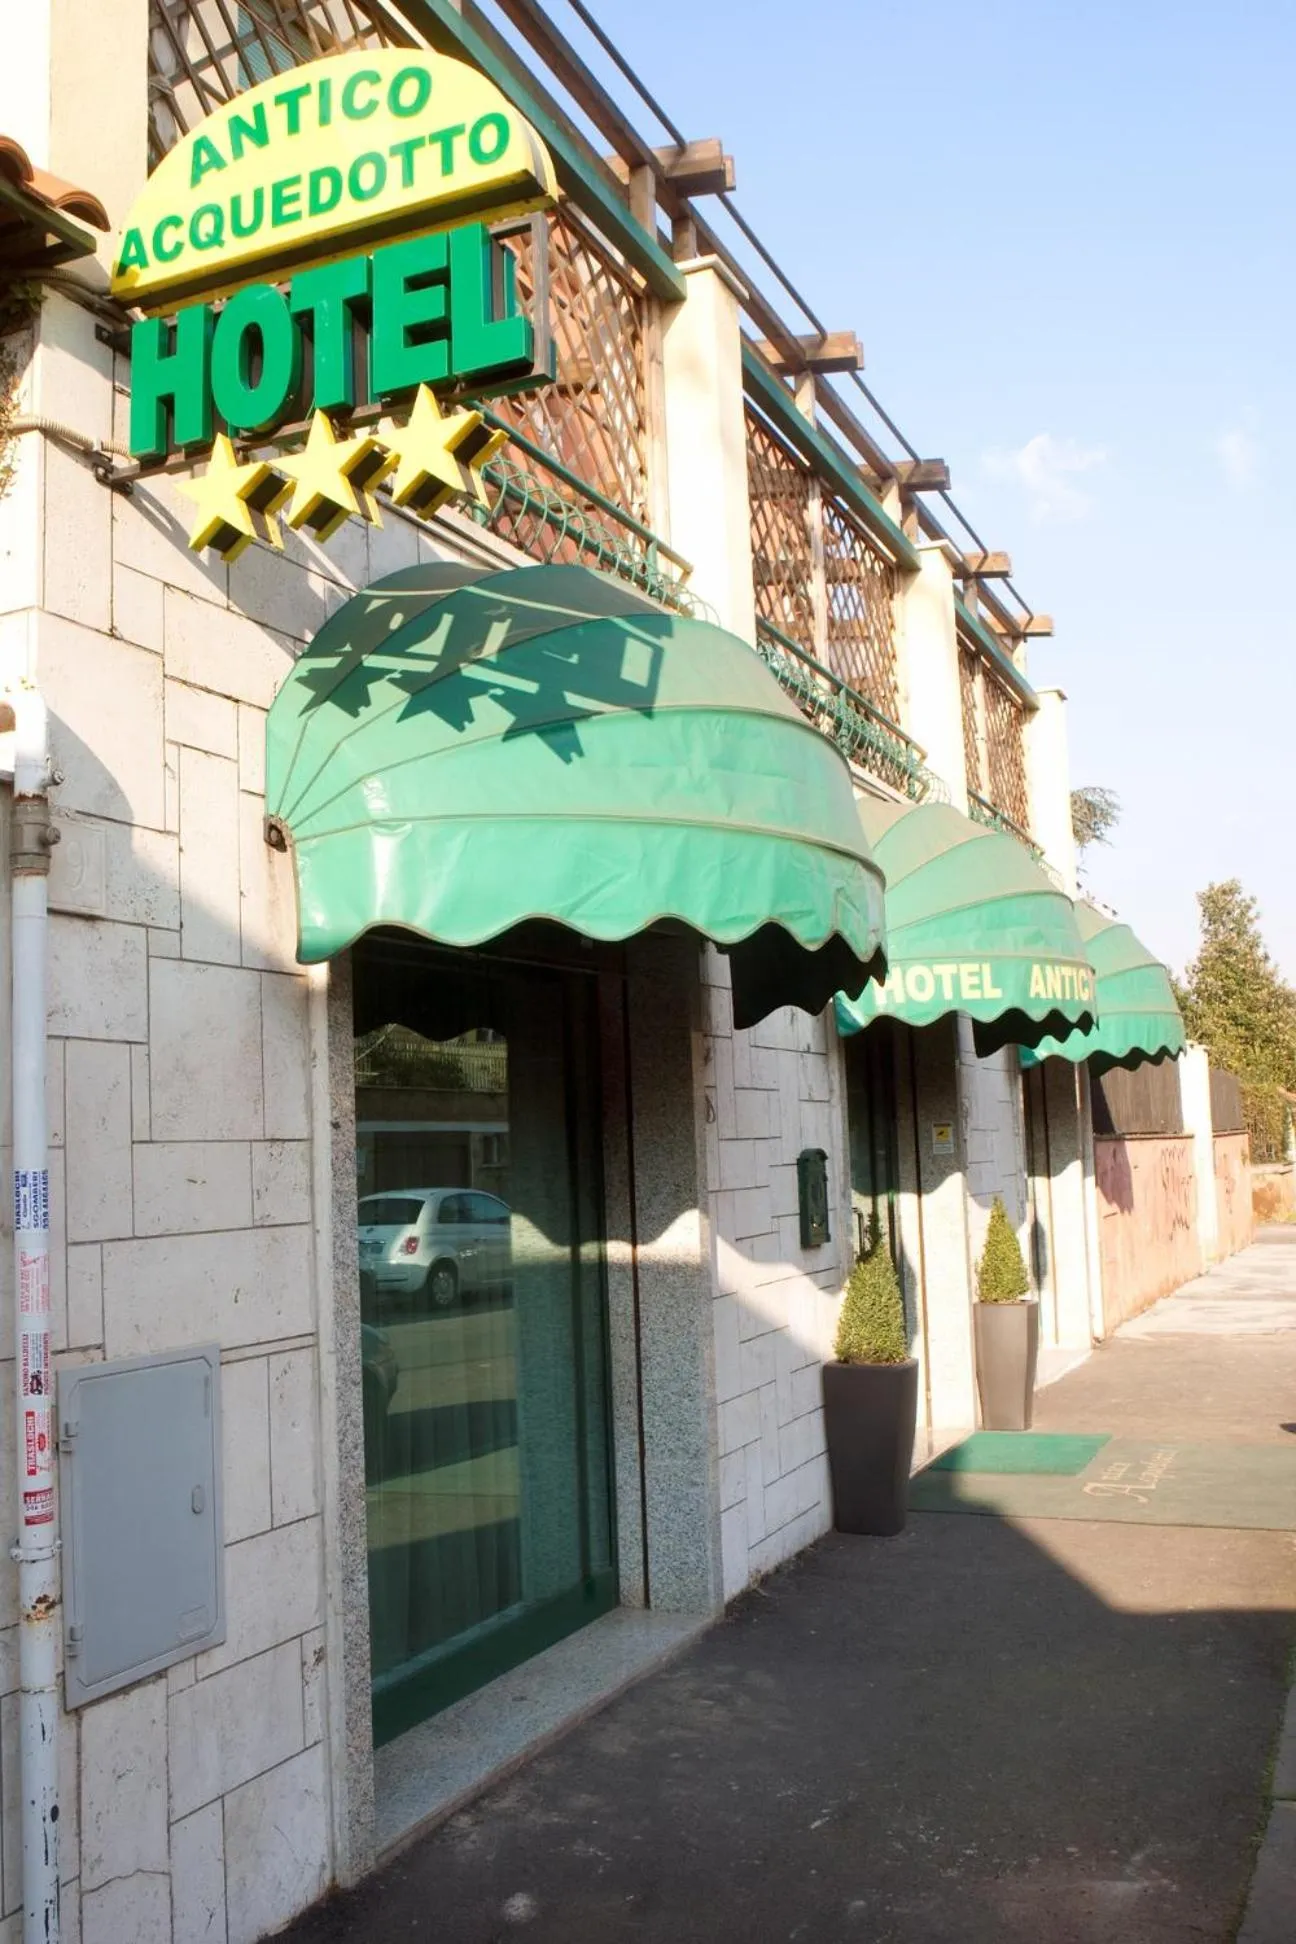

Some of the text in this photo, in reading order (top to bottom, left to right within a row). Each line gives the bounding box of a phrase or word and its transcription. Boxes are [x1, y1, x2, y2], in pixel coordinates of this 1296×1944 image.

[116, 112, 510, 277] ACQUEDOTTO
[190, 66, 432, 188] ANTICO
[130, 222, 534, 459] HOTEL
[873, 963, 1093, 1006] HOTEL ANTIC
